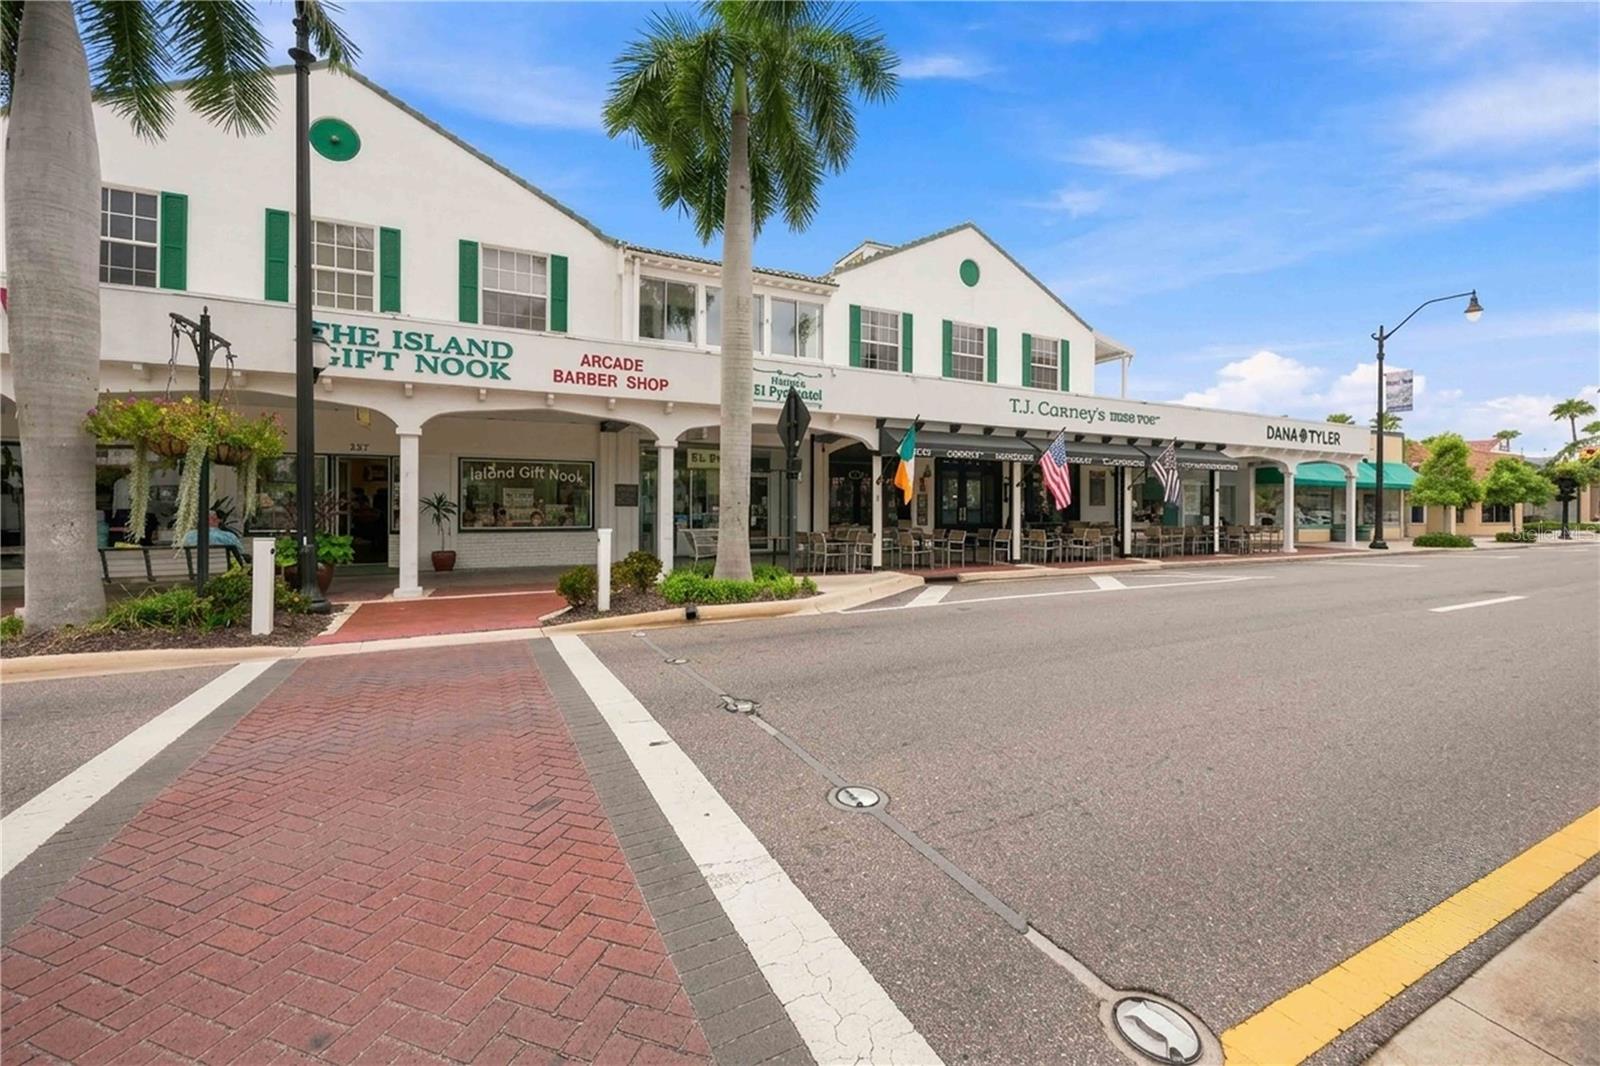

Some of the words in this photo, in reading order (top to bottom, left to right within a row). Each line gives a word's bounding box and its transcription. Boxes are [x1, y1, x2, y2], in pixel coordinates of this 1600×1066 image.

[393, 330, 513, 359] ISLAND
[415, 354, 511, 380] NOOK
[580, 354, 644, 372] ARCADE
[553, 369, 618, 388] BARBER
[626, 376, 669, 391] SHOP
[1009, 398, 1034, 415] T.J.
[1038, 401, 1106, 424] Carney's
[1266, 425, 1298, 442] DANA
[1308, 429, 1341, 445] TYLER
[519, 466, 545, 479] Gift
[549, 468, 584, 484] Nook
